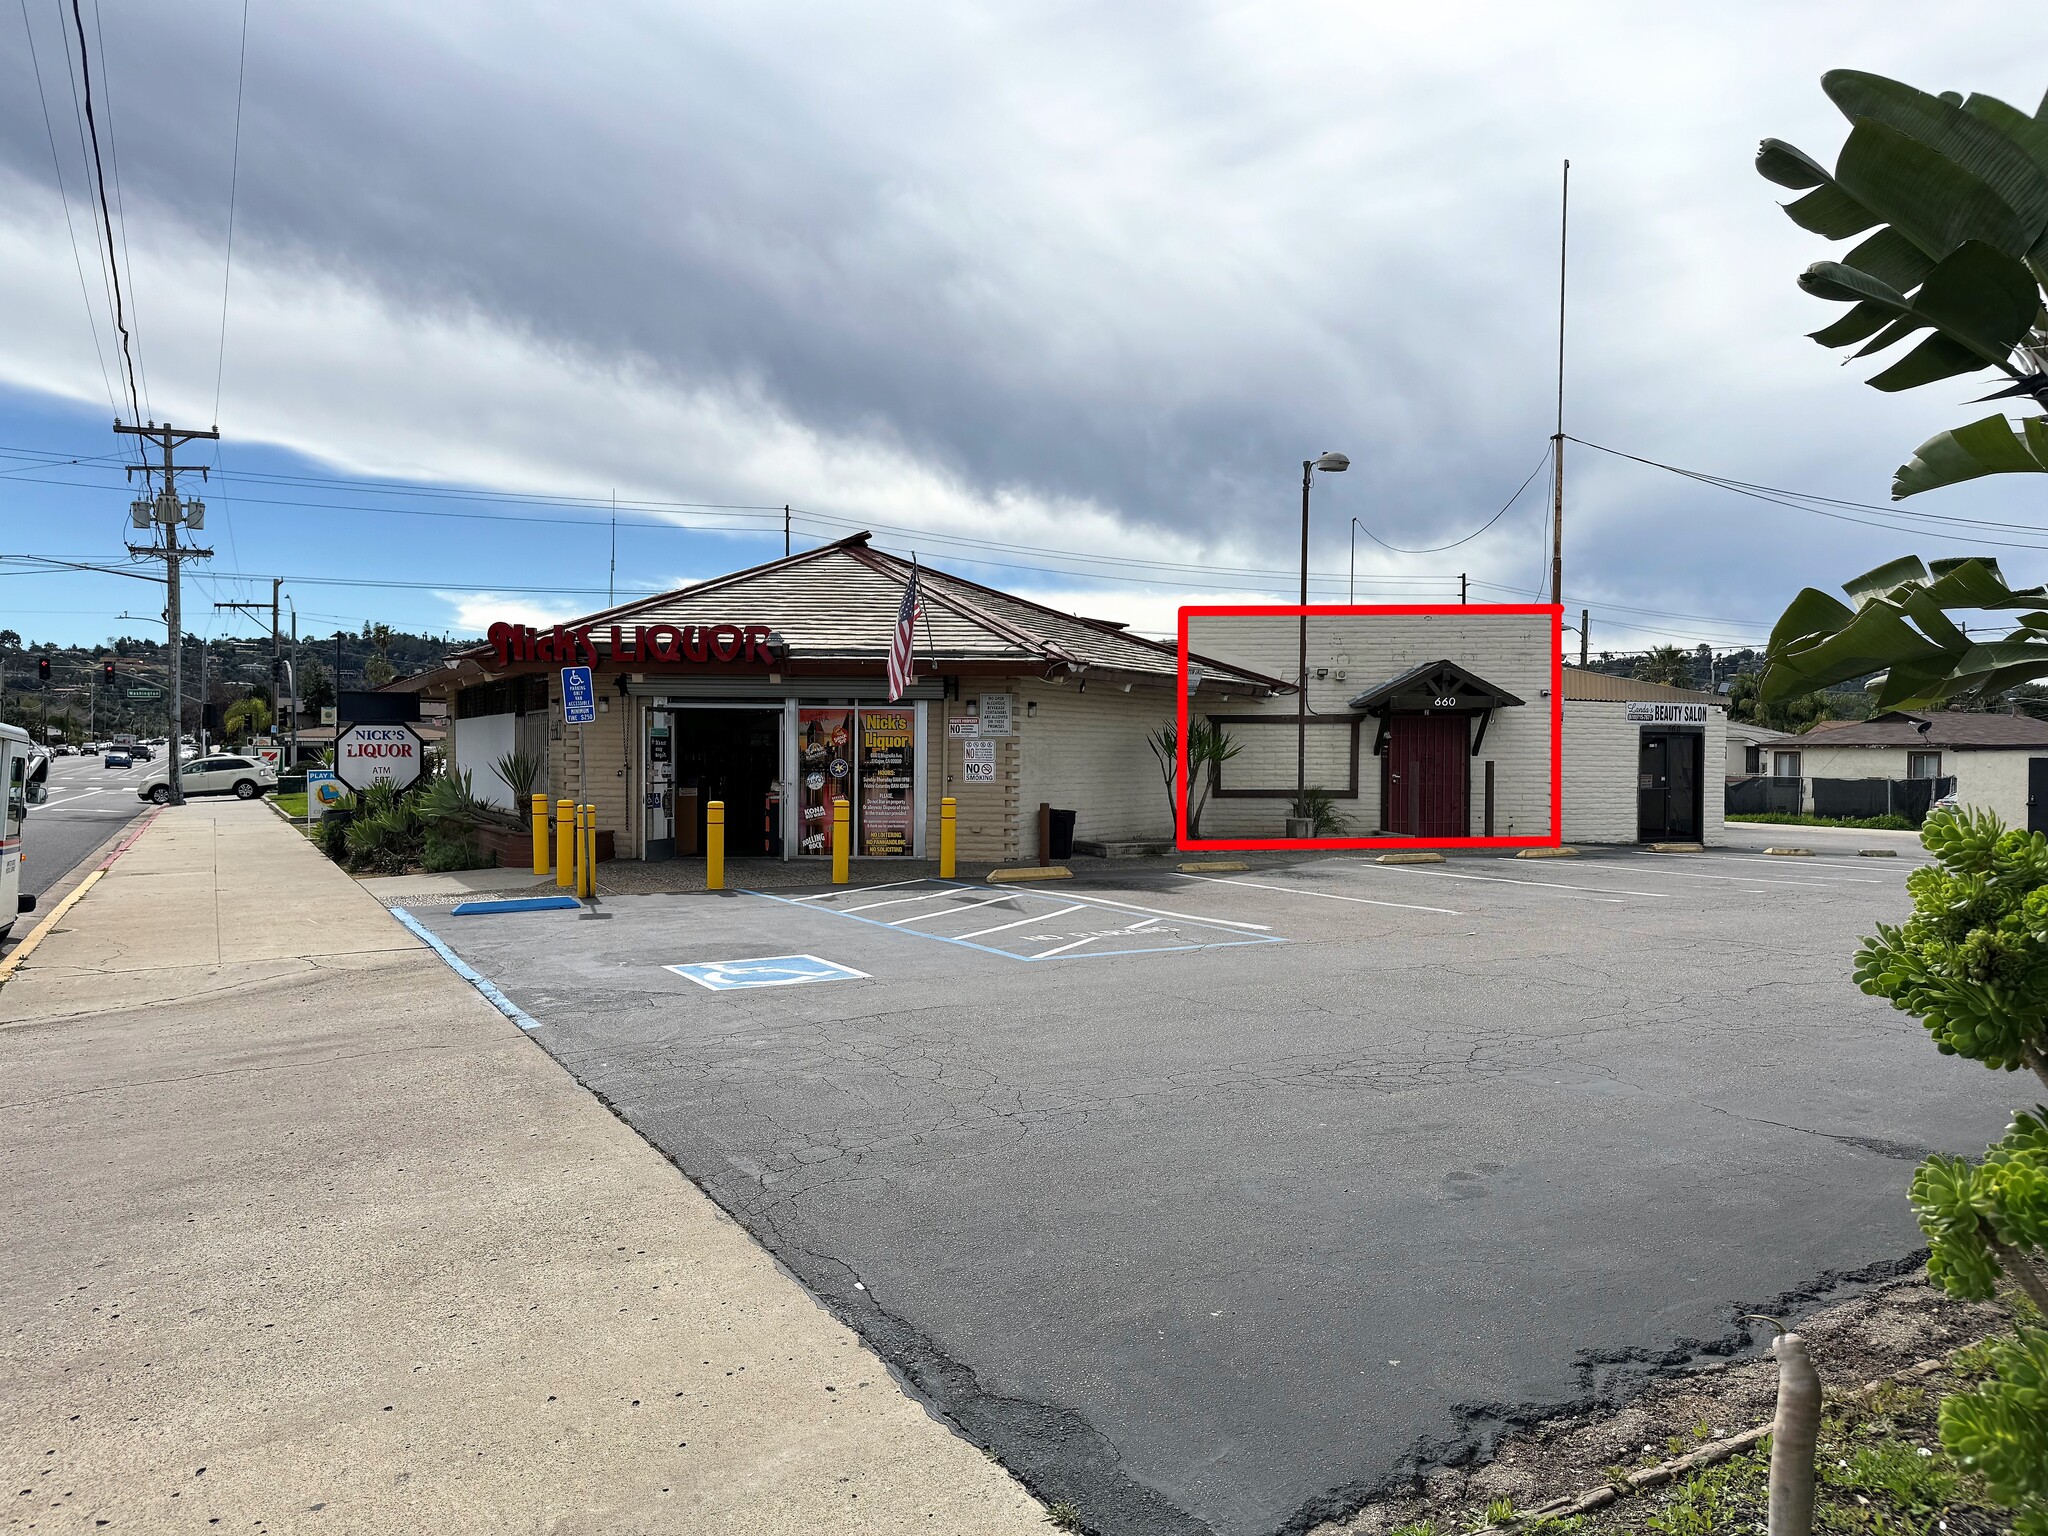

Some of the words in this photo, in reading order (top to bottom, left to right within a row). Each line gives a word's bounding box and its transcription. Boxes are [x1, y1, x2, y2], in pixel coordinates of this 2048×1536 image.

[611, 625, 776, 667] LIQUOR
[1434, 697, 1456, 707] 660
[1655, 705, 1682, 721] BEAUTY
[1684, 706, 1707, 722] SALON
[866, 715, 907, 729] Nick's
[950, 724, 960, 734] NO
[355, 730, 405, 740] NICK'S
[866, 732, 909, 750] Liquor
[346, 744, 413, 758] LIQUOR
[966, 748, 974, 758] NO
[966, 764, 980, 774] NO
[804, 806, 825, 815] KONA
[802, 833, 825, 846] ROLLING
[809, 841, 823, 850] ROCK
